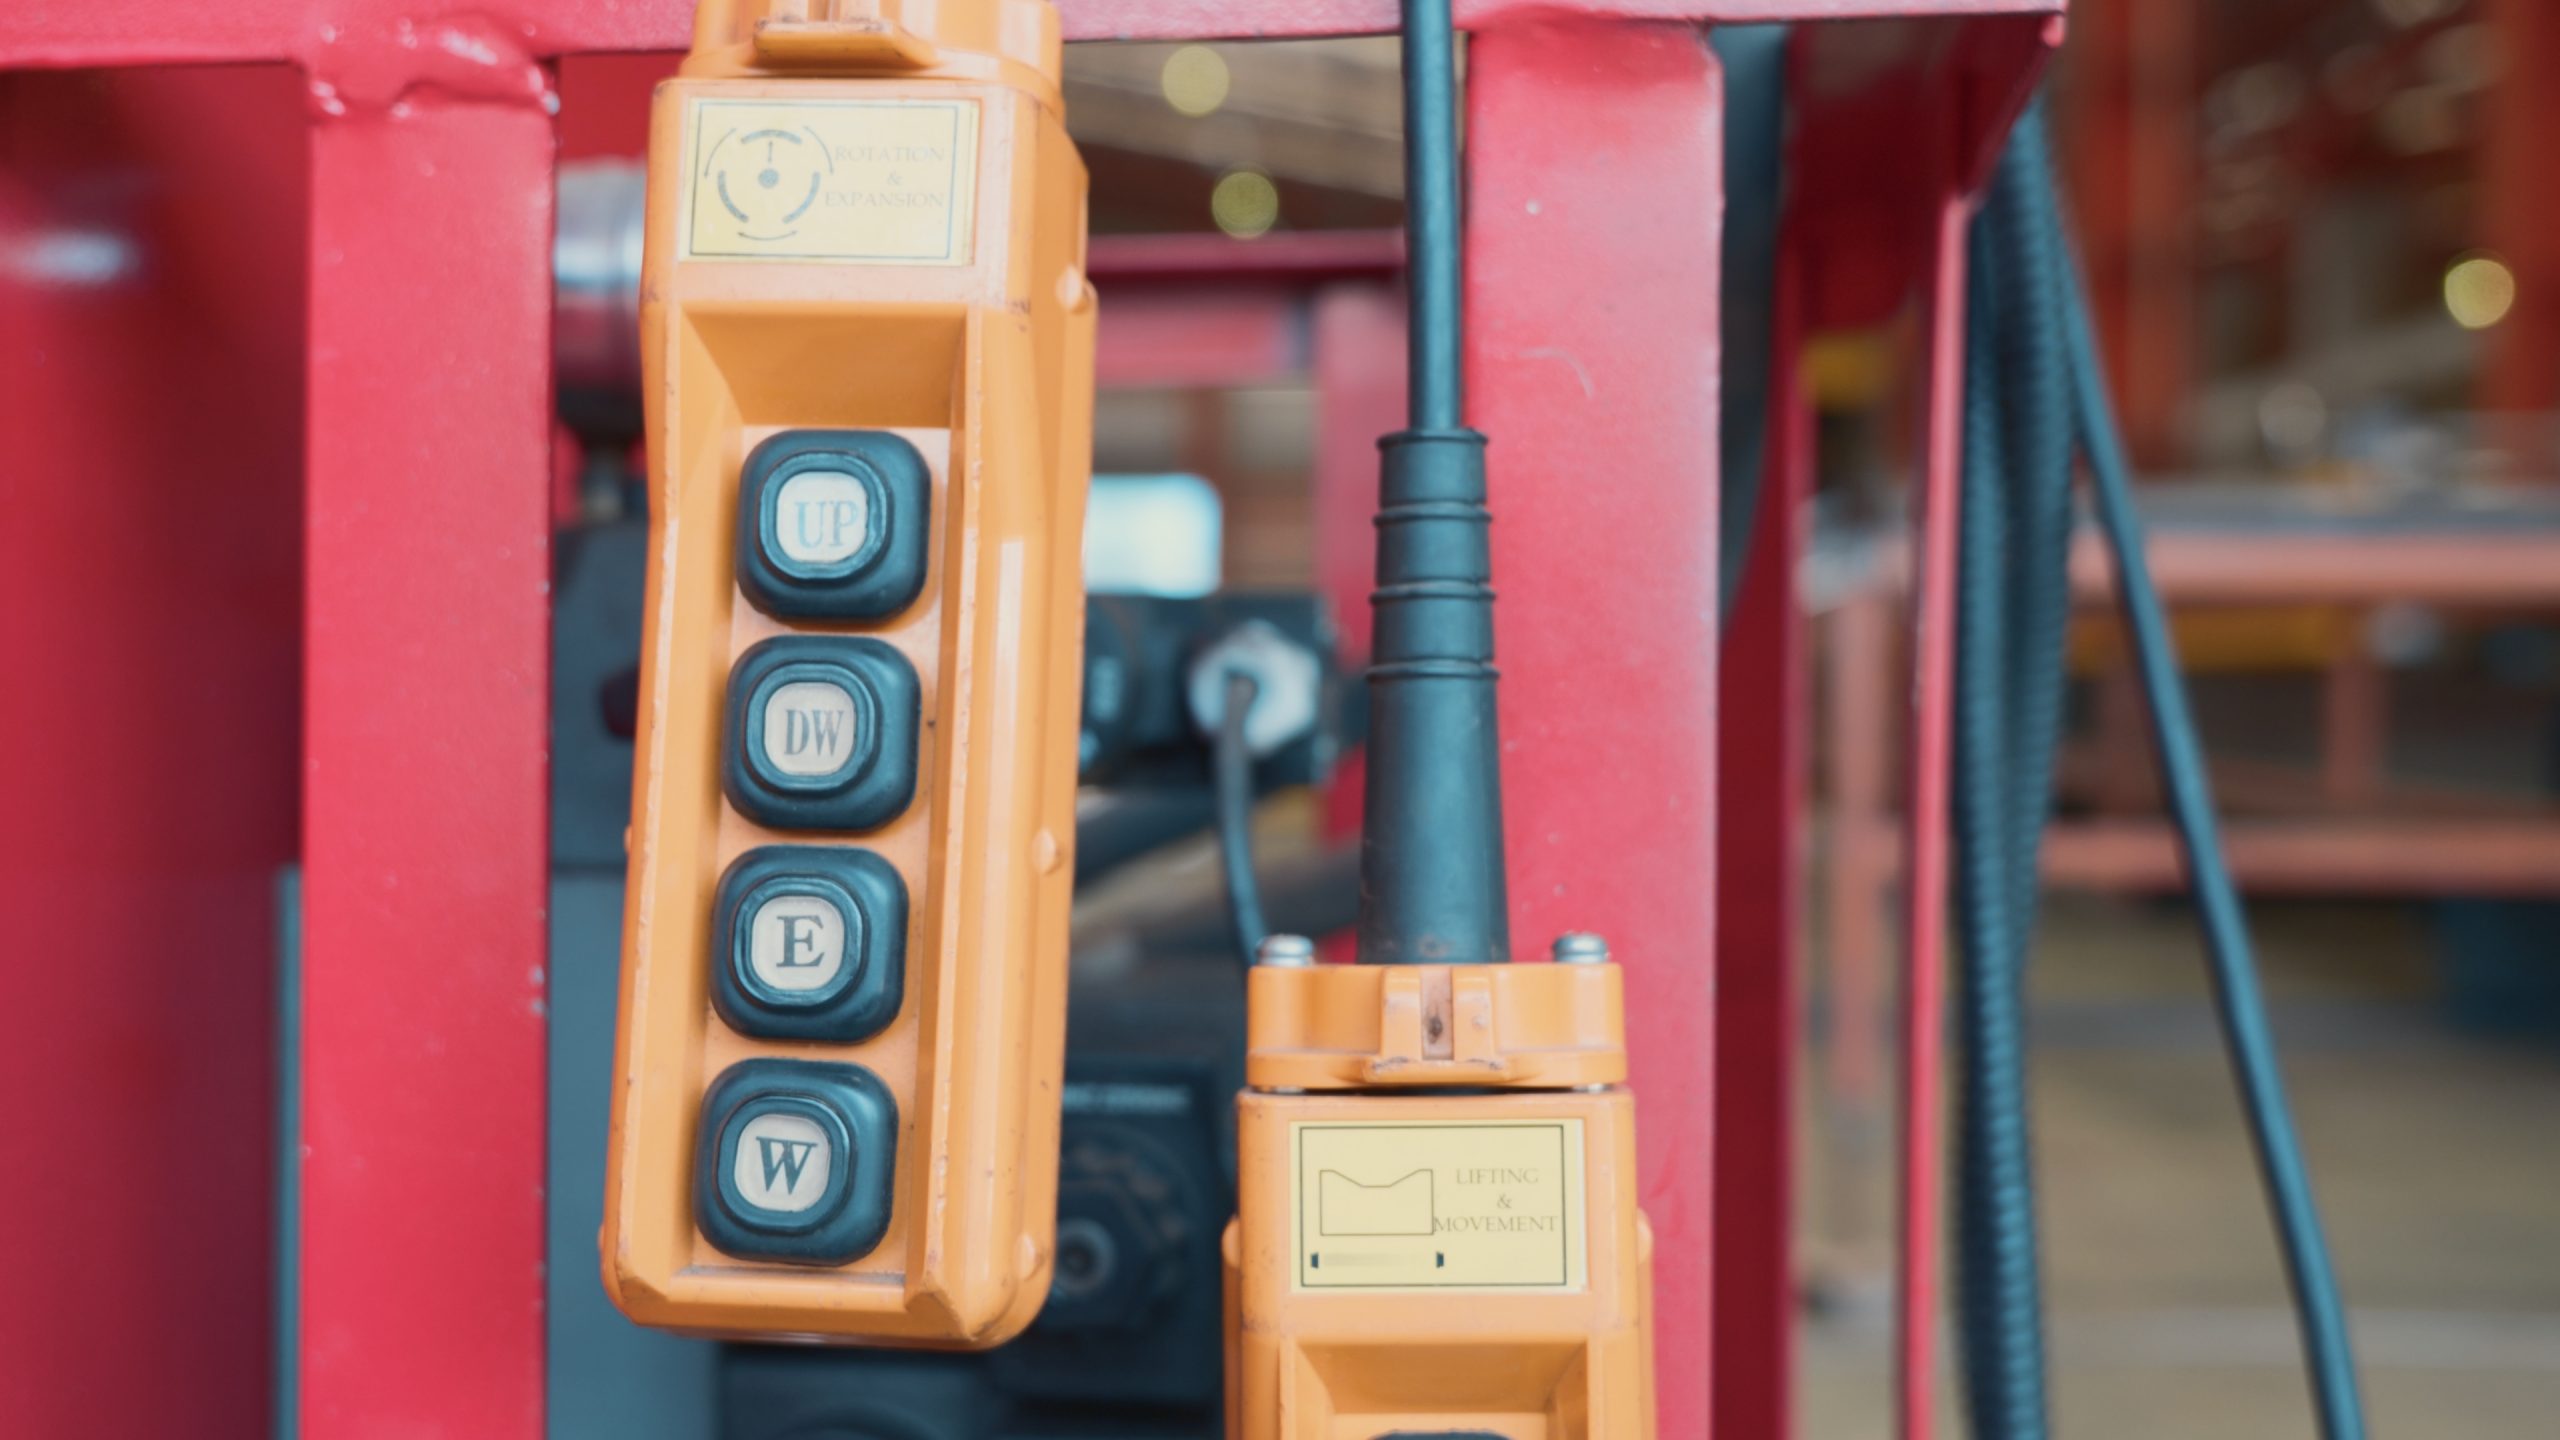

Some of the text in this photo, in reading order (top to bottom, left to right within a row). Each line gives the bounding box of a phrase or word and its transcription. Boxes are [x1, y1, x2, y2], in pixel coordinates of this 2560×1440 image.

[834, 146, 944, 162] ROTATION
[886, 170, 903, 185] &
[825, 191, 943, 208] EXPANSION
[794, 500, 859, 549] UP
[783, 708, 845, 757] DW
[775, 915, 826, 969] E
[755, 1136, 819, 1196] W
[1456, 1168, 1539, 1184] LIFTING
[1496, 1193, 1513, 1210] &
[1433, 1215, 1558, 1233] MOVEMENT
